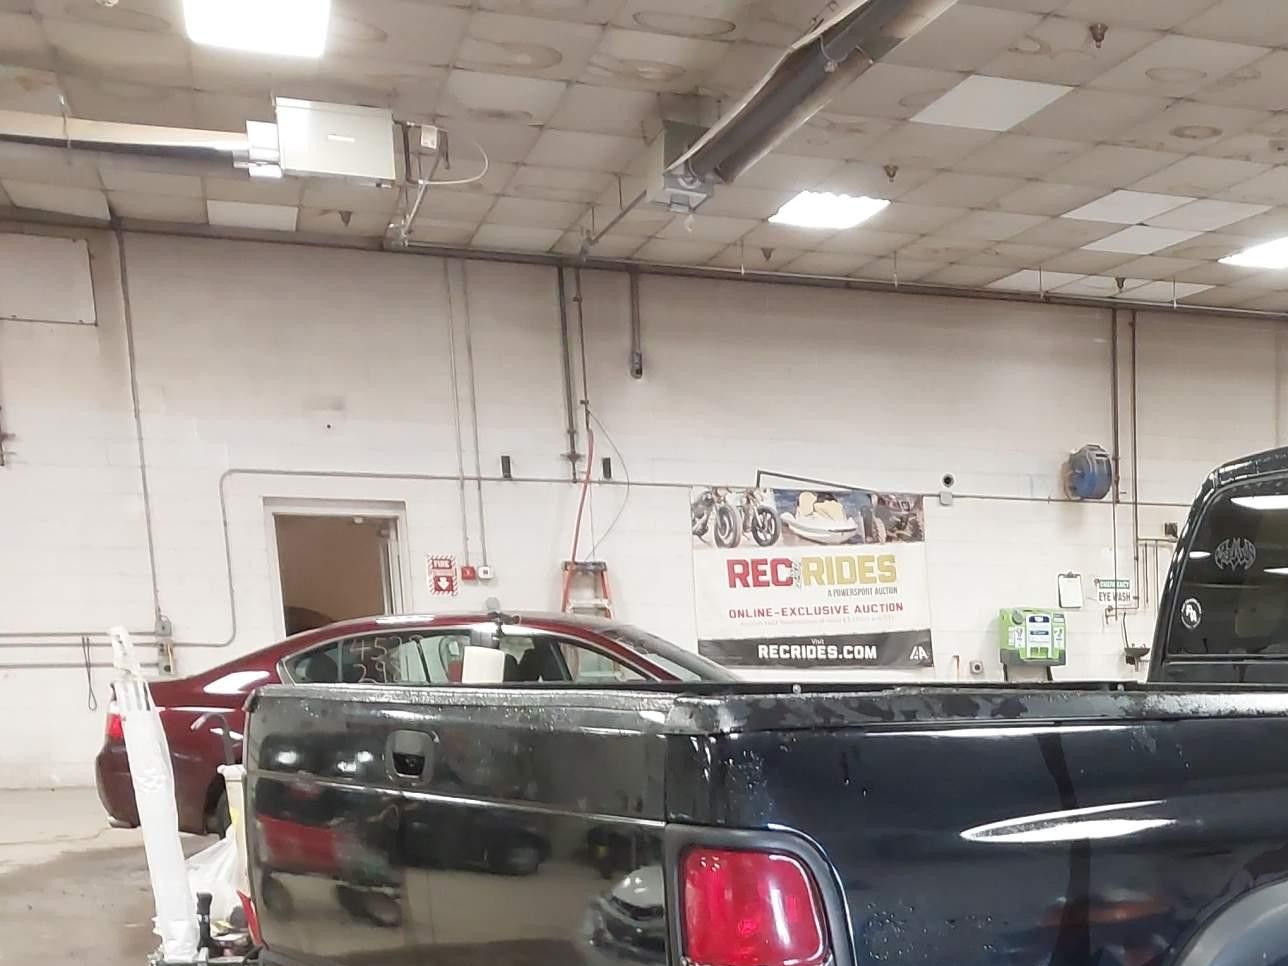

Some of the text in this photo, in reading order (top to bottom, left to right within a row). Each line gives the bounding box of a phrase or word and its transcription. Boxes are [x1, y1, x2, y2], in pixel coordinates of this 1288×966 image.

[801, 554, 898, 587] RIDES
[1099, 591, 1111, 602] EYE
[729, 602, 904, 619] ONLINE-EXCLUSIVE AUCTION
[758, 644, 878, 660] RECRIDES.COM
